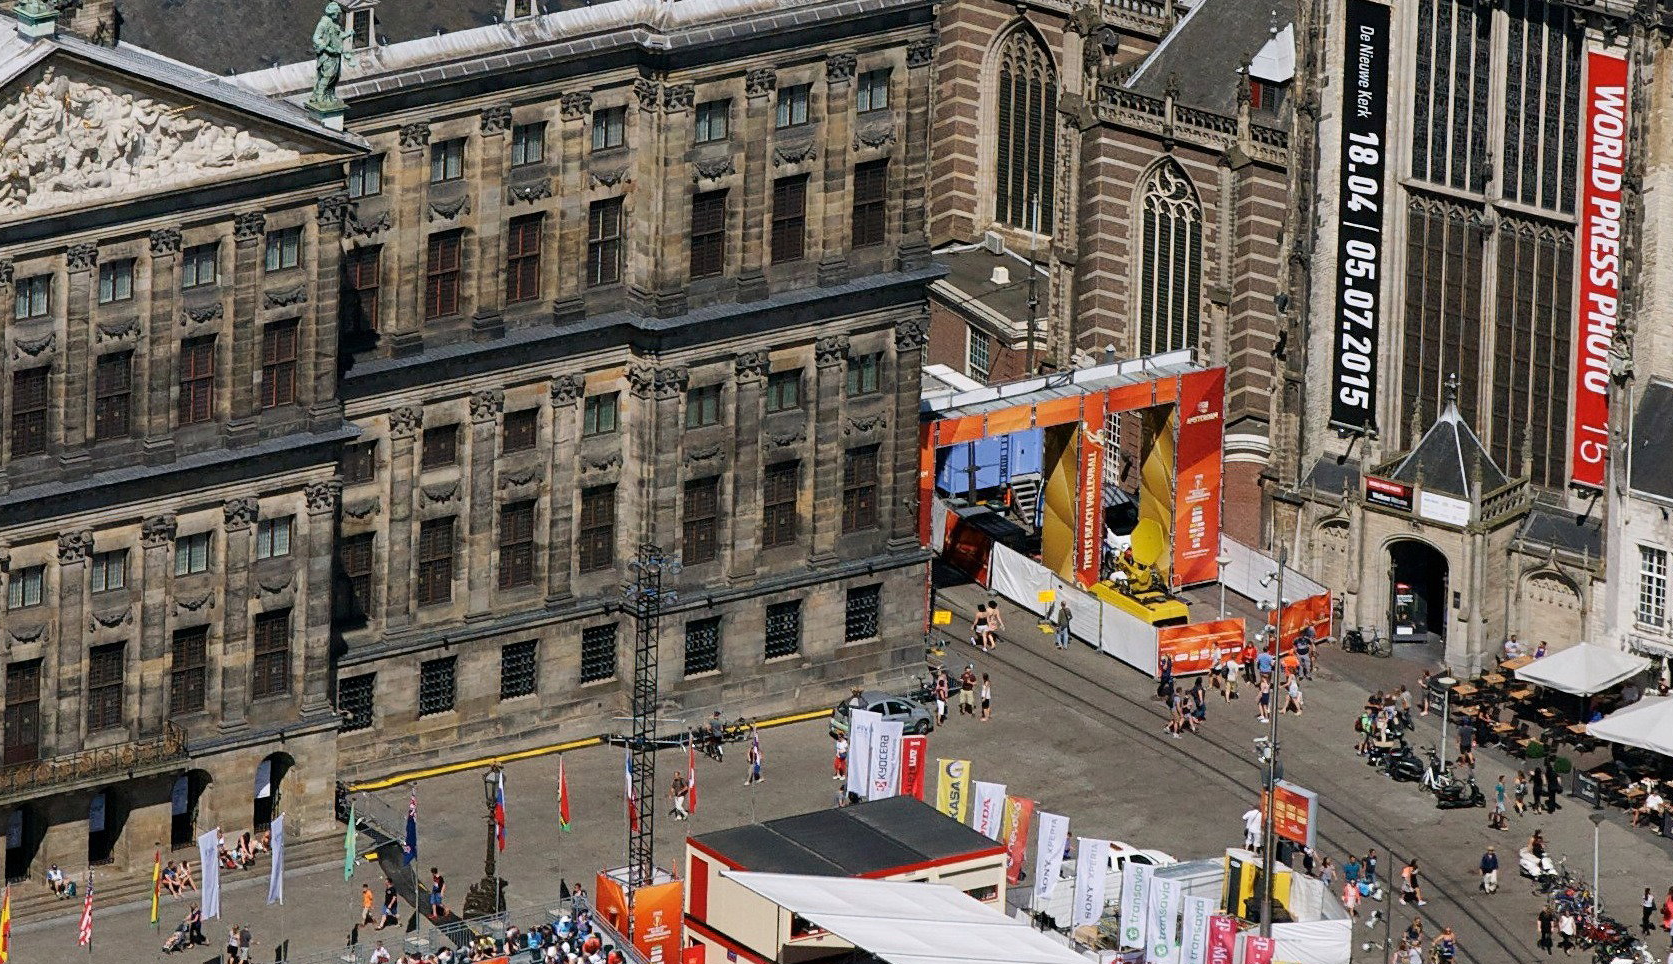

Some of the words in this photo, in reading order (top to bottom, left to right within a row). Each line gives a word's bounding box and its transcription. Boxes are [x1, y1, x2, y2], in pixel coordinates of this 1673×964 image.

[1359, 25, 1375, 42] De
[1358, 45, 1373, 87] Nieuwe
[1357, 90, 1370, 118] Kerk
[1591, 85, 1627, 192] WORLD
[1347, 131, 1380, 213] 18.04
[1589, 196, 1621, 291] PRESS
[1340, 239, 1377, 411] 05.07.2015
[1584, 293, 1619, 396] PHOTO
[1085, 507, 1095, 538] BEACH
[877, 735, 889, 780] KYOCERA
[1042, 860, 1052, 893] SONY
[1048, 818, 1058, 855] XPERIA
[1088, 843, 1099, 879] XPERIA
[1085, 887, 1094, 919] SONY
[1130, 866, 1144, 924] transavia
[1159, 882, 1171, 940] transavia
[1191, 900, 1204, 960] transavia
